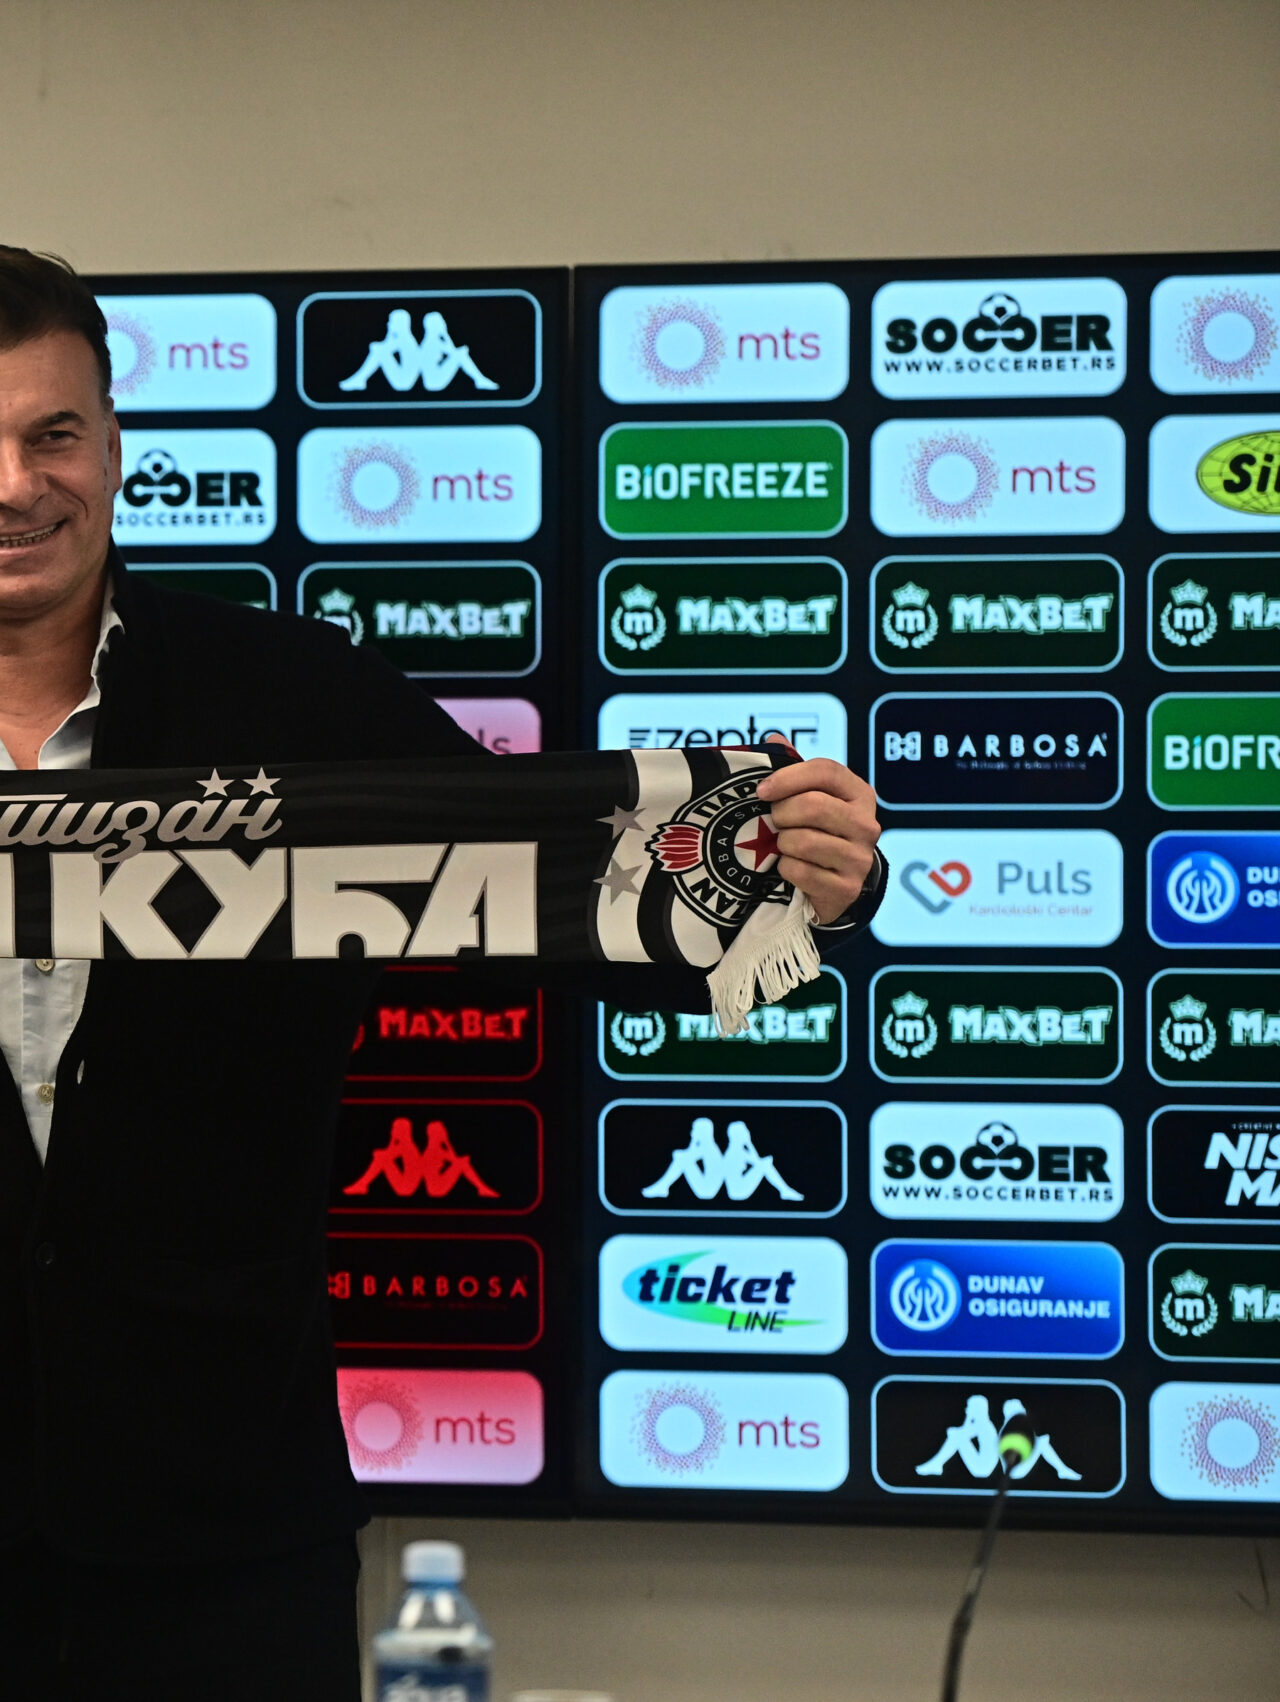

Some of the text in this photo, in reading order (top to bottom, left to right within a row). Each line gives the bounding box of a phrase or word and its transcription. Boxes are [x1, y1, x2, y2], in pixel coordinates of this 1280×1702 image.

[738, 328, 820, 360] mts
[885, 314, 1112, 354] SOCCER
[169, 338, 248, 370] mts
[885, 357, 1115, 372] WWW.SOCCERBET.RS
[123, 472, 263, 507] CCER
[433, 469, 513, 501] mts
[1012, 461, 1096, 493] mts
[1223, 453, 1280, 494] Si
[934, 733, 1107, 757] BARBOSA
[717, 804, 762, 886] UDBALSK
[998, 862, 1092, 895] Puls
[50, 842, 539, 959] КУБА
[883, 1144, 1111, 1182] SOCCER
[883, 1185, 1114, 1202] WWW.SOCCERBET.RS
[363, 1275, 526, 1297] BARBOSA
[638, 1263, 795, 1306] ticket
[968, 1275, 1045, 1294] DUNAV
[727, 1310, 786, 1333] LINE
[968, 1297, 1111, 1319] OSIGURANJE
[434, 1413, 516, 1445] mts
[738, 1416, 820, 1448] mts
